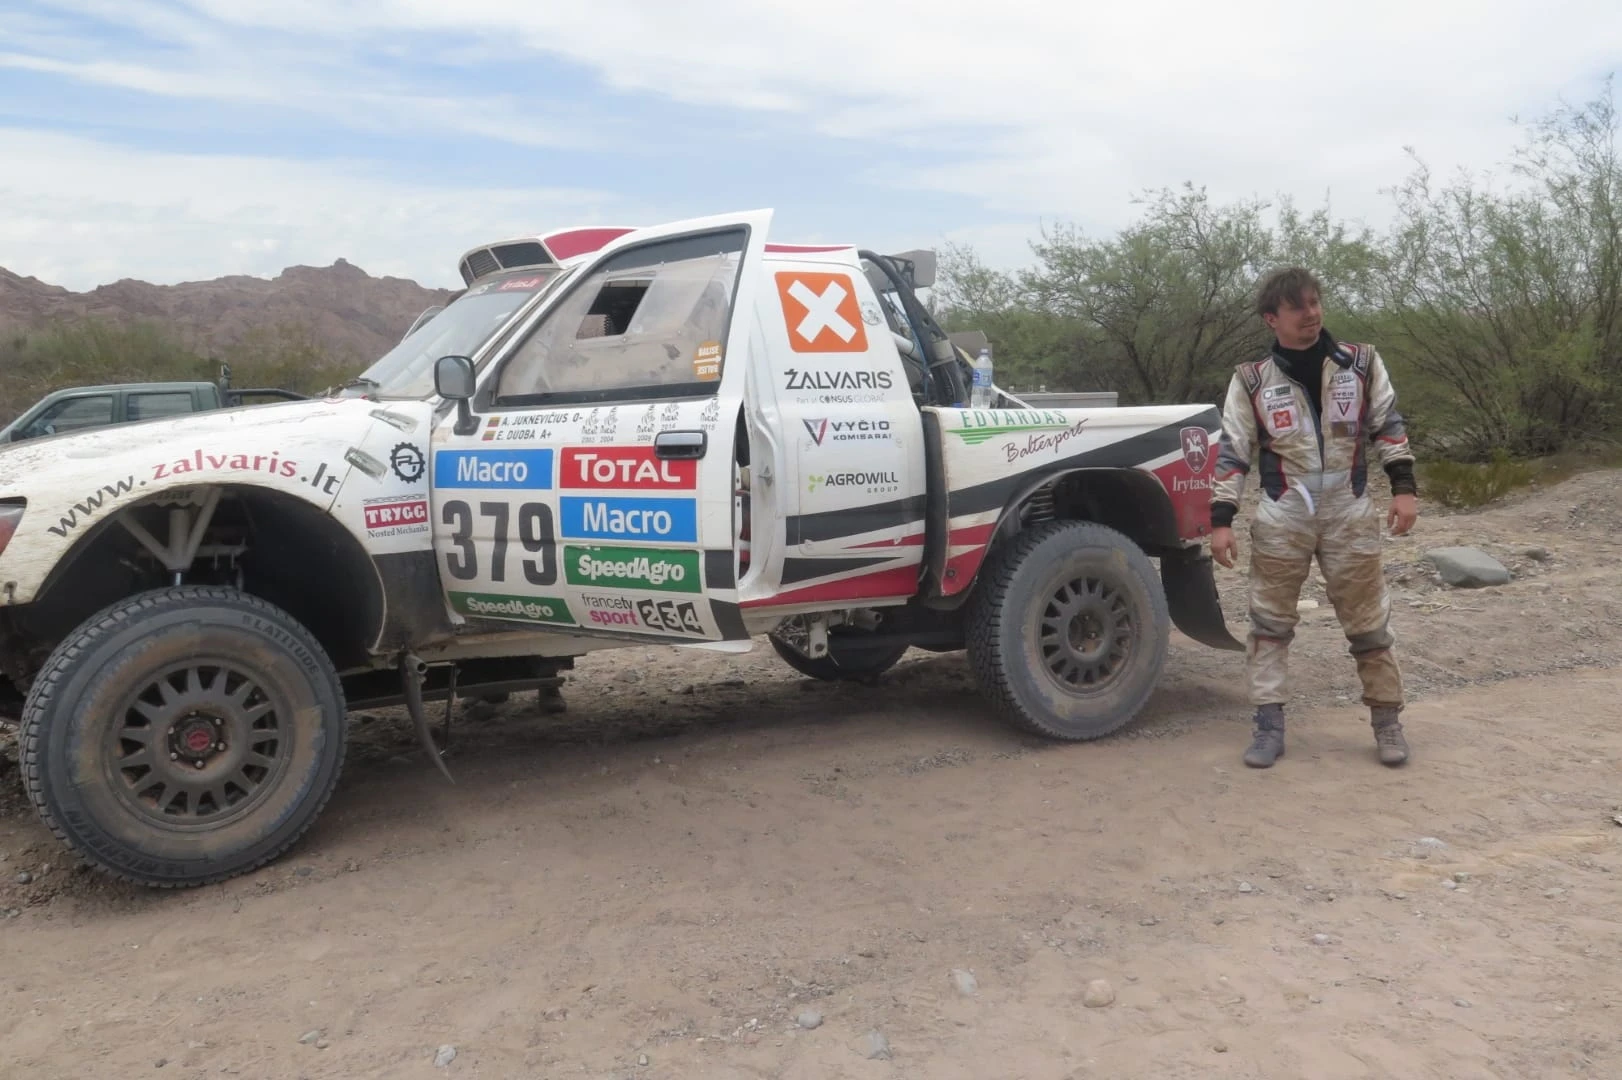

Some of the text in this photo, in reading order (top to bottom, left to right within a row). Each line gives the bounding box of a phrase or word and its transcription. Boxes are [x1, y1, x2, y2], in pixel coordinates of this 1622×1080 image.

[784, 368, 893, 390] ŽALVARIS
[831, 419, 890, 432] VYČIO
[962, 409, 1068, 428] EDVARDAS
[507, 429, 536, 440] DUOBA
[833, 432, 892, 441] KOMISARAI
[1002, 417, 1090, 463] Baltexport
[457, 456, 528, 483] Macro
[574, 453, 681, 483] TOTAL
[825, 471, 899, 487] AGROWILL
[47, 449, 341, 538] www.zalvaris.lt
[867, 486, 899, 494] GROUP
[366, 505, 426, 524] TRYGG
[583, 502, 672, 535] Macro
[367, 527, 396, 539] Nosted
[442, 500, 558, 586] 379
[578, 554, 685, 584] SpeedAgro
[466, 596, 554, 619] SpeedAgro
[582, 593, 633, 611] francetv
[590, 609, 639, 627] sport
[254, 619, 320, 675] LATITUDE
